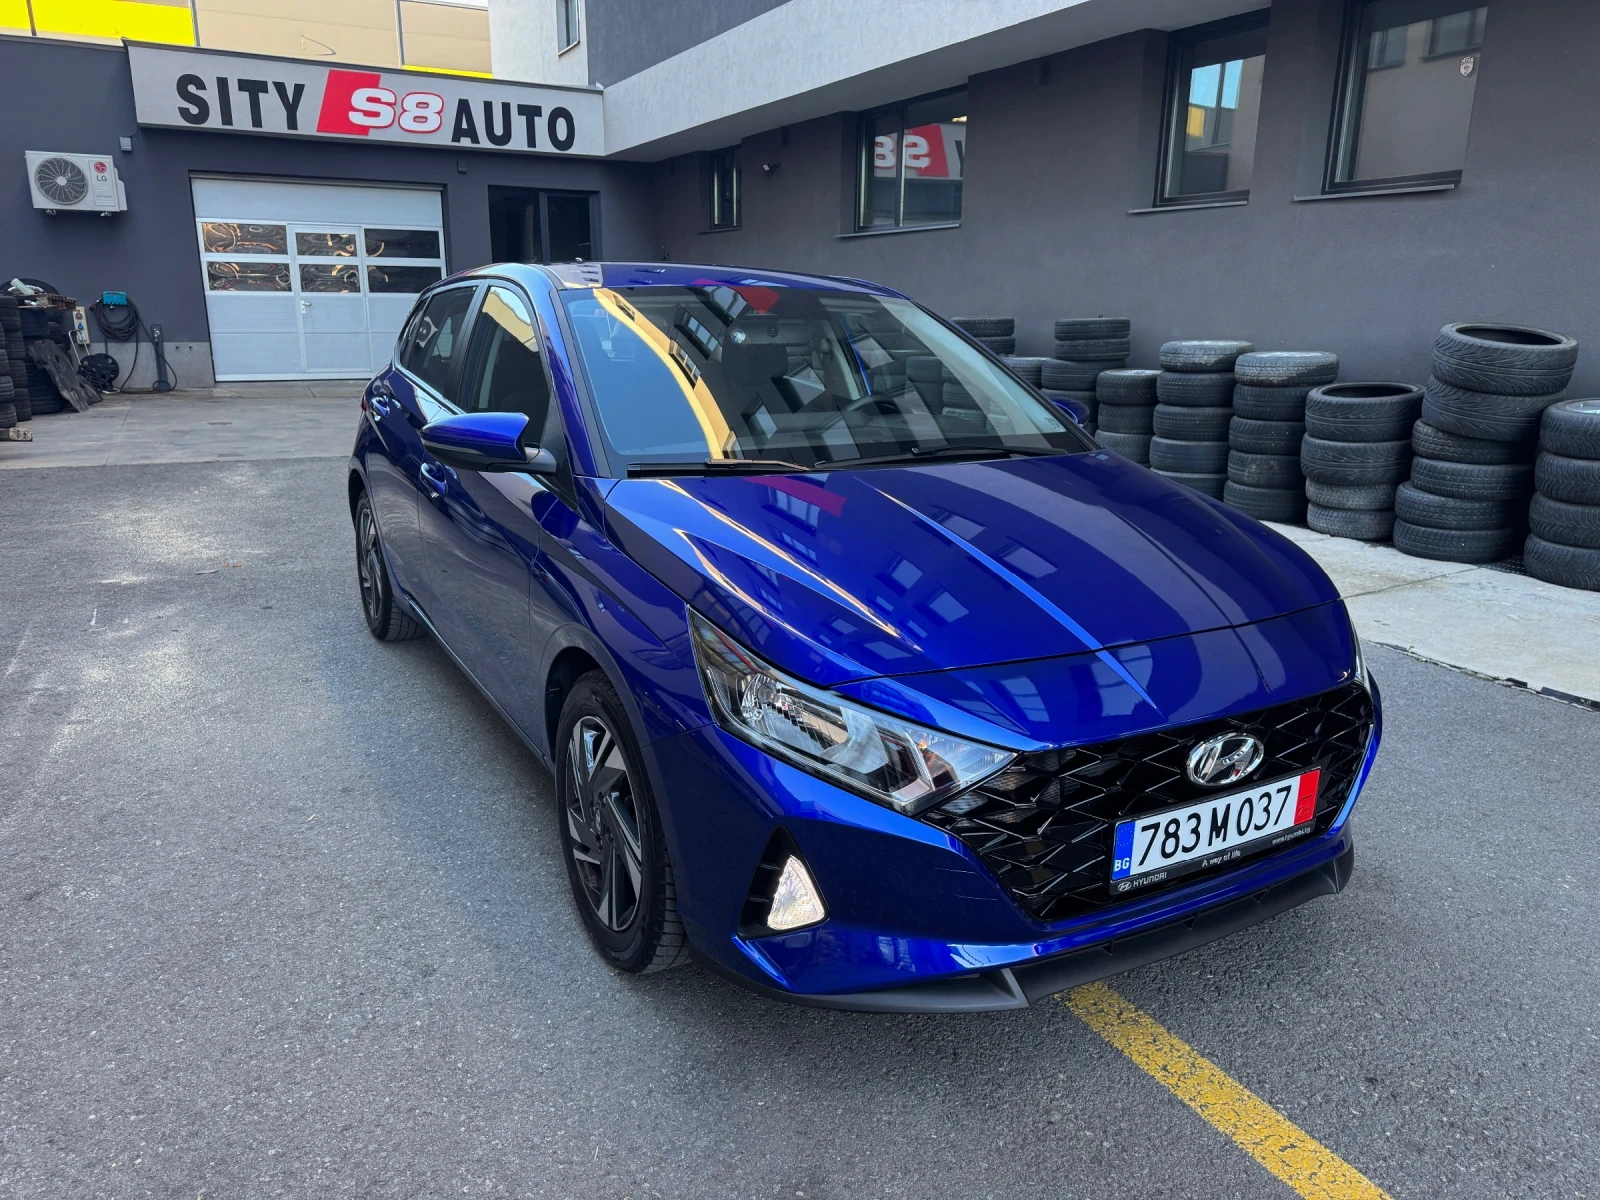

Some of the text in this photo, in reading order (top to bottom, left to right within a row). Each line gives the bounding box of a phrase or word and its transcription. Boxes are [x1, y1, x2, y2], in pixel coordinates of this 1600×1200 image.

[176, 73, 576, 152] SITY S8 AUTO
[1138, 785, 1292, 867] 783 M 037
[1113, 857, 1130, 872] BG
[1202, 859, 1208, 867] A
[1223, 852, 1231, 861] of
[1133, 871, 1168, 888] HYUNDAI
